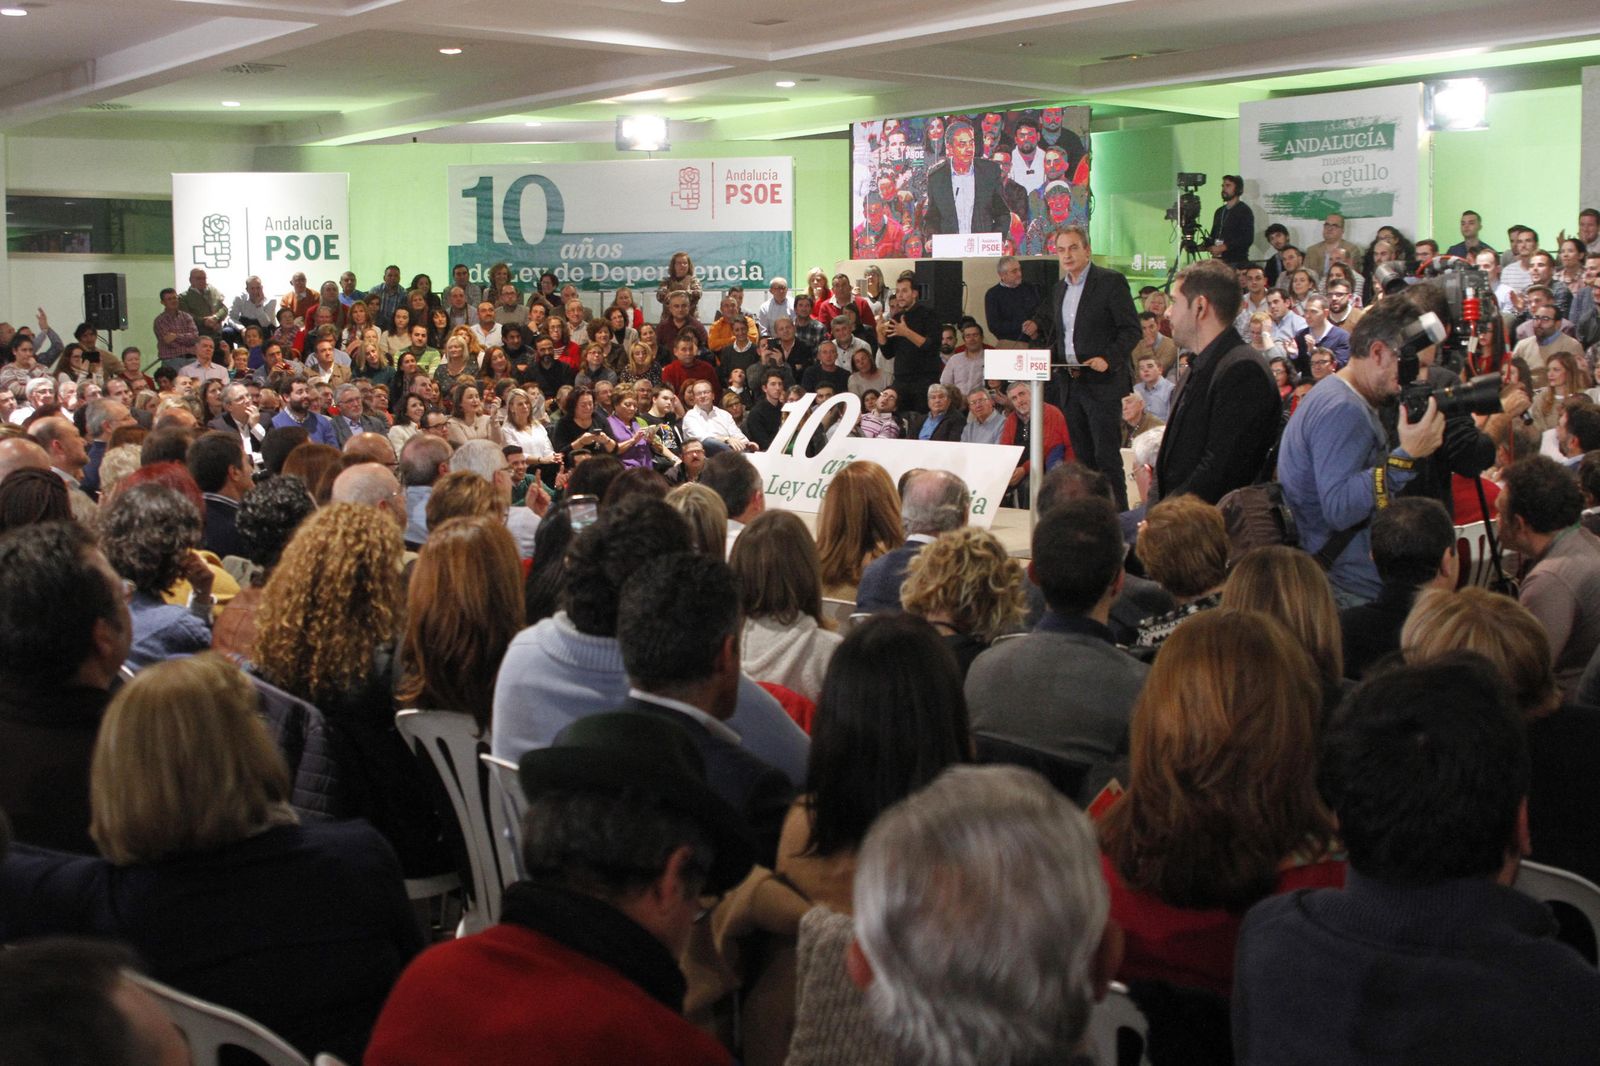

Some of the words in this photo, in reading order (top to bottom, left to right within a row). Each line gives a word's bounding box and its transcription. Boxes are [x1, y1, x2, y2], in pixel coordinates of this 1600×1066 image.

[1283, 127, 1388, 155] ANDALUCÍA
[1321, 154, 1365, 167] nuestro
[725, 168, 779, 182] Andalucía
[1321, 163, 1389, 188] orgullo
[725, 183, 783, 205] PSOE
[265, 215, 333, 231] Andalucía
[462, 174, 565, 249] 10
[265, 234, 340, 261] PSOE
[560, 237, 624, 260] años
[981, 243, 1001, 252] PSOE
[554, 263, 585, 282] de
[589, 259, 764, 287] Depenencia
[1148, 260, 1168, 270] PSOE
[1030, 361, 1048, 371] PSOE
[766, 392, 862, 459] 10
[764, 474, 806, 502] Ley
